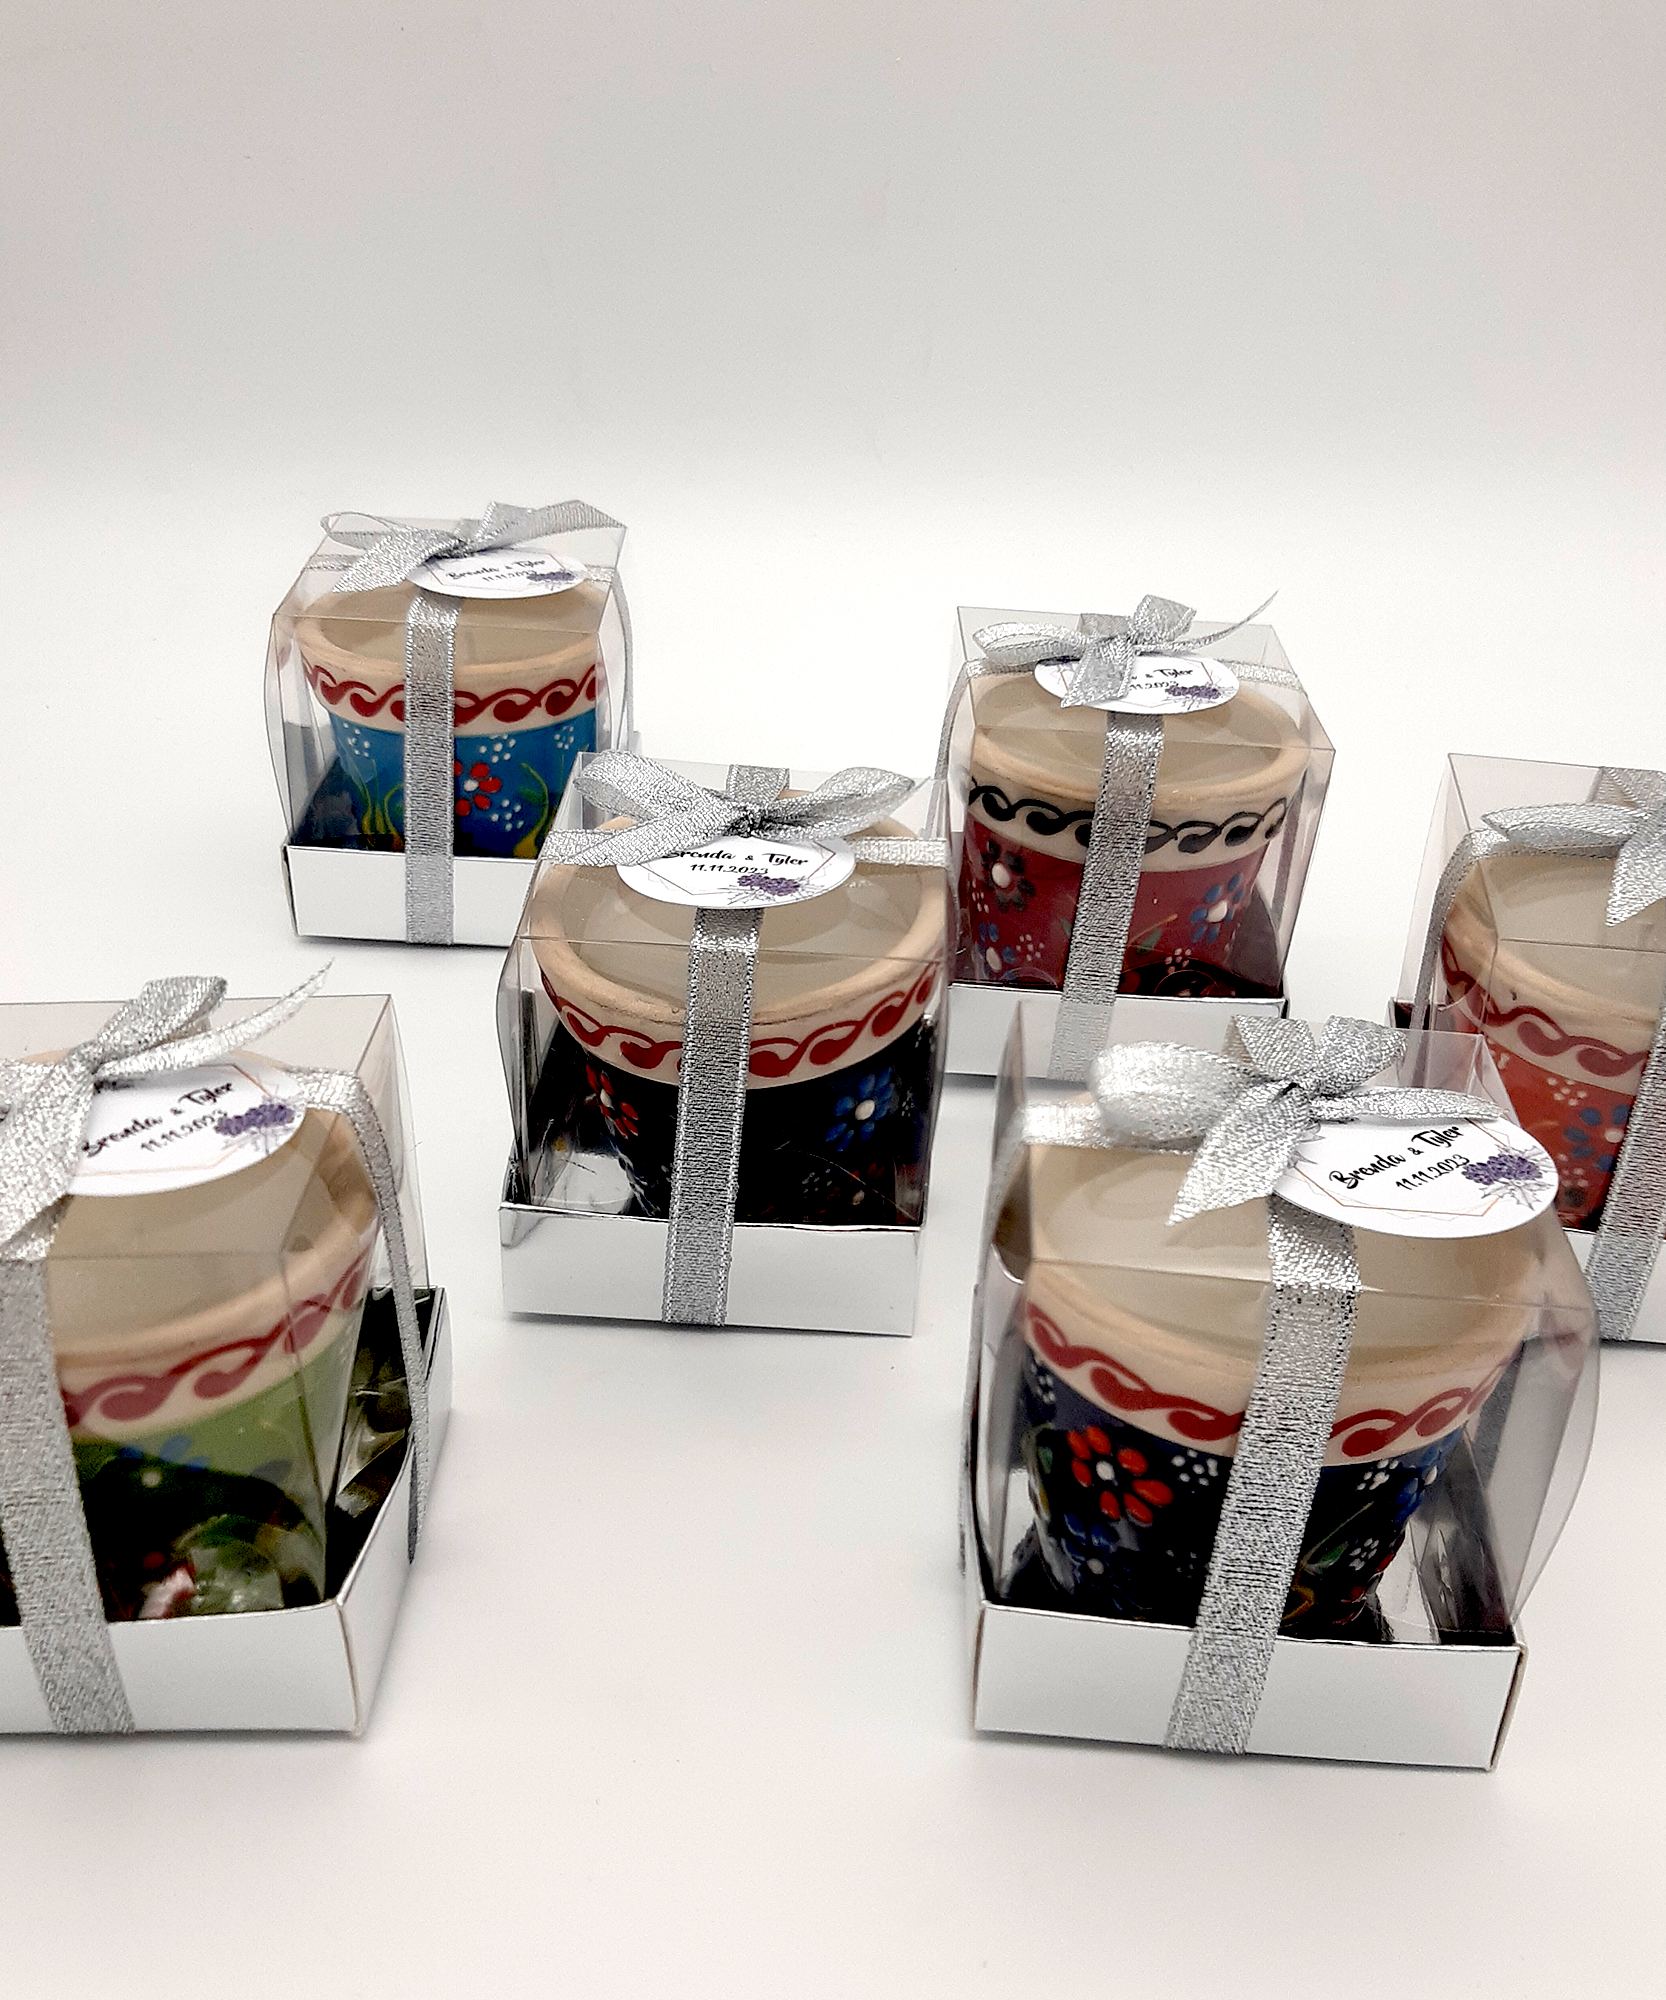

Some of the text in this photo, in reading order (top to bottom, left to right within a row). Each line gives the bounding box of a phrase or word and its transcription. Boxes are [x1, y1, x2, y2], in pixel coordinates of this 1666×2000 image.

[1153, 668, 1193, 679] Tyler
[689, 862, 769, 876] 11.11.2023
[761, 852, 809, 866] Tyler
[81, 1117, 163, 1157] Brenda
[178, 1082, 233, 1105] Tyler
[1329, 1125, 1466, 1190] Brenda & Tyler
[1395, 1154, 1470, 1191] 11.11.2023
